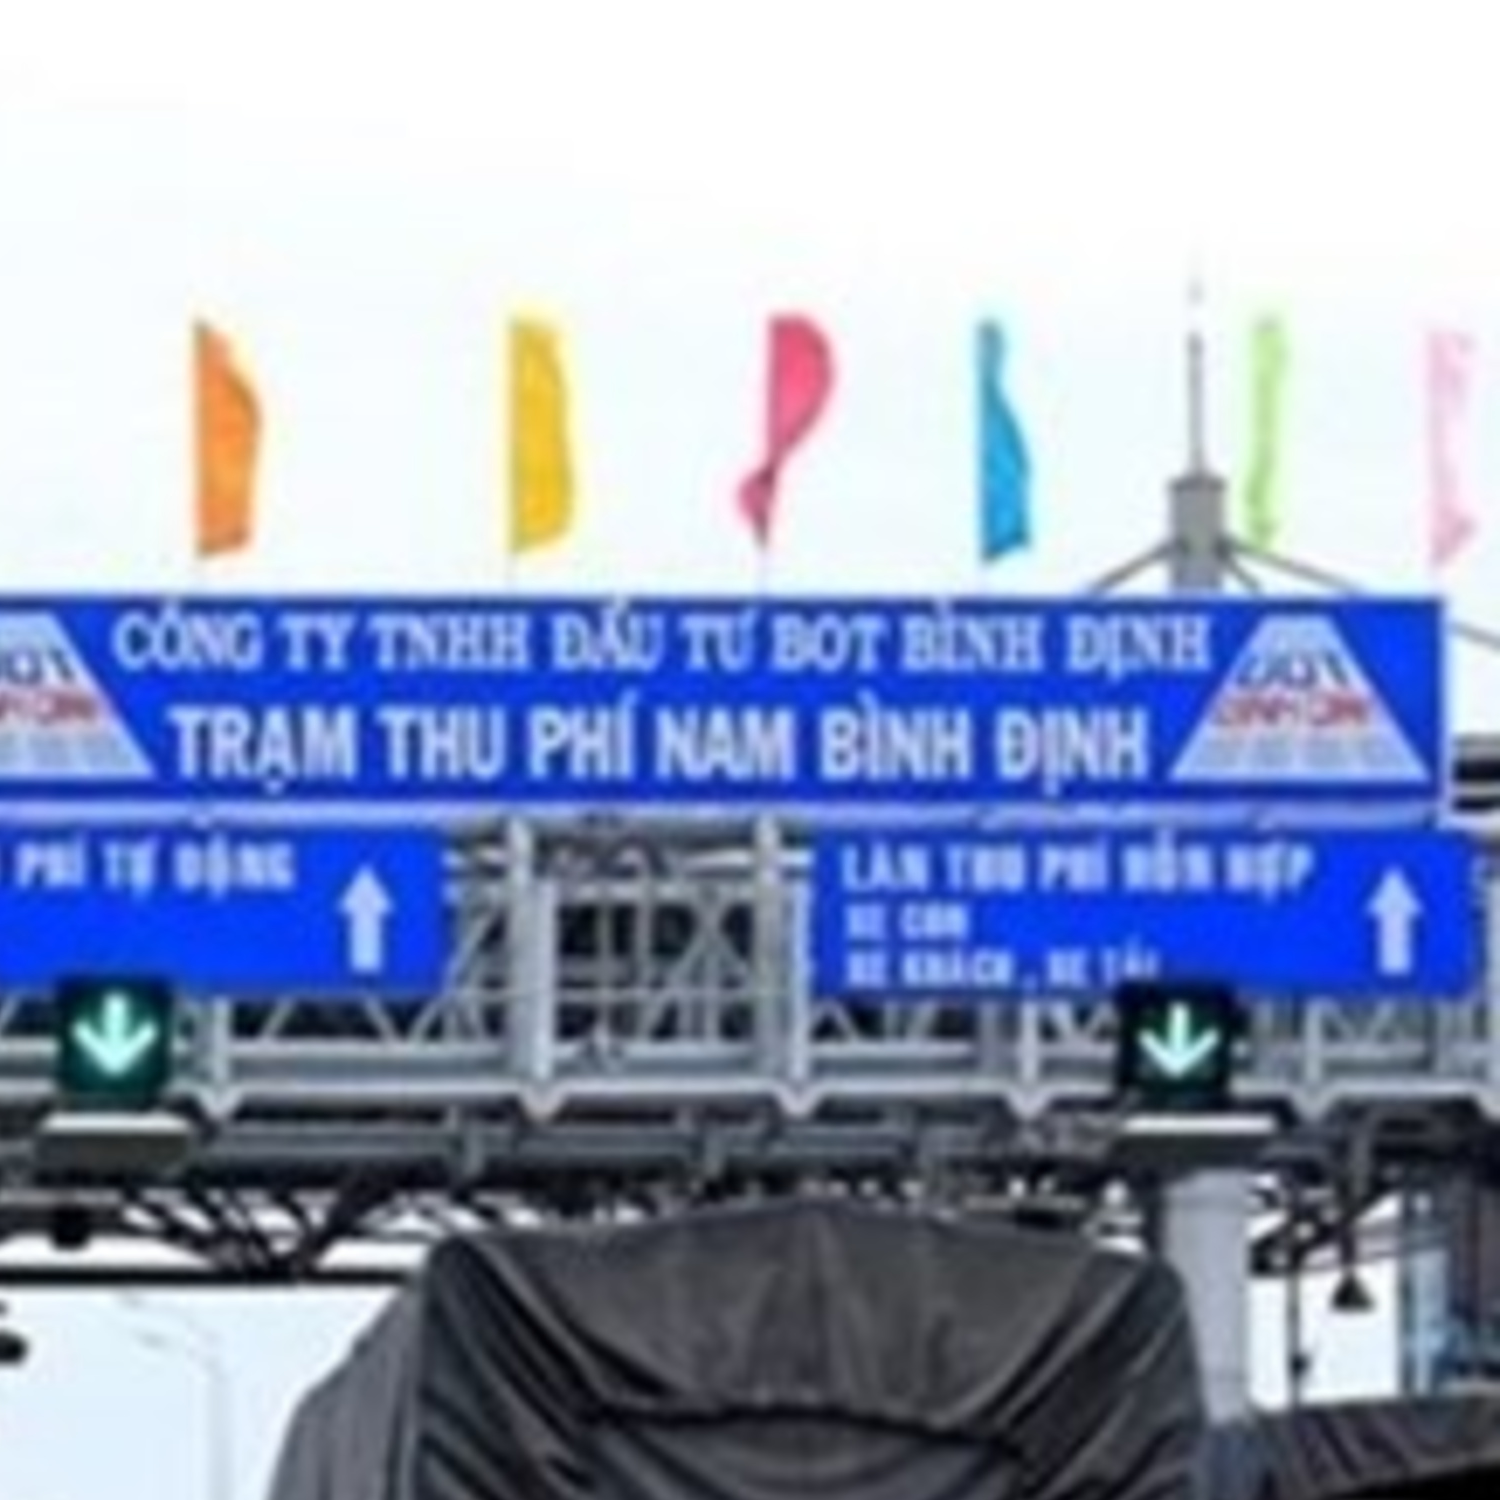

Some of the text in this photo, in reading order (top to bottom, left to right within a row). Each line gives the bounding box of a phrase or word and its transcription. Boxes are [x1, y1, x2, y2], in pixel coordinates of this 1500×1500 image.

[112, 597, 264, 672] CÔNG
[280, 614, 358, 671] TY
[368, 614, 530, 671] TNHH
[771, 614, 889, 672] BOT
[903, 600, 1045, 672] BÌNH
[1066, 614, 1213, 683] ĐỊNH
[167, 690, 1150, 794] TRẠM THU PHÍ NAM BÌNH ĐỊNH
[14, 832, 86, 888] PHÍ
[946, 843, 1027, 891] THU
[1039, 836, 1110, 891] PHÍ
